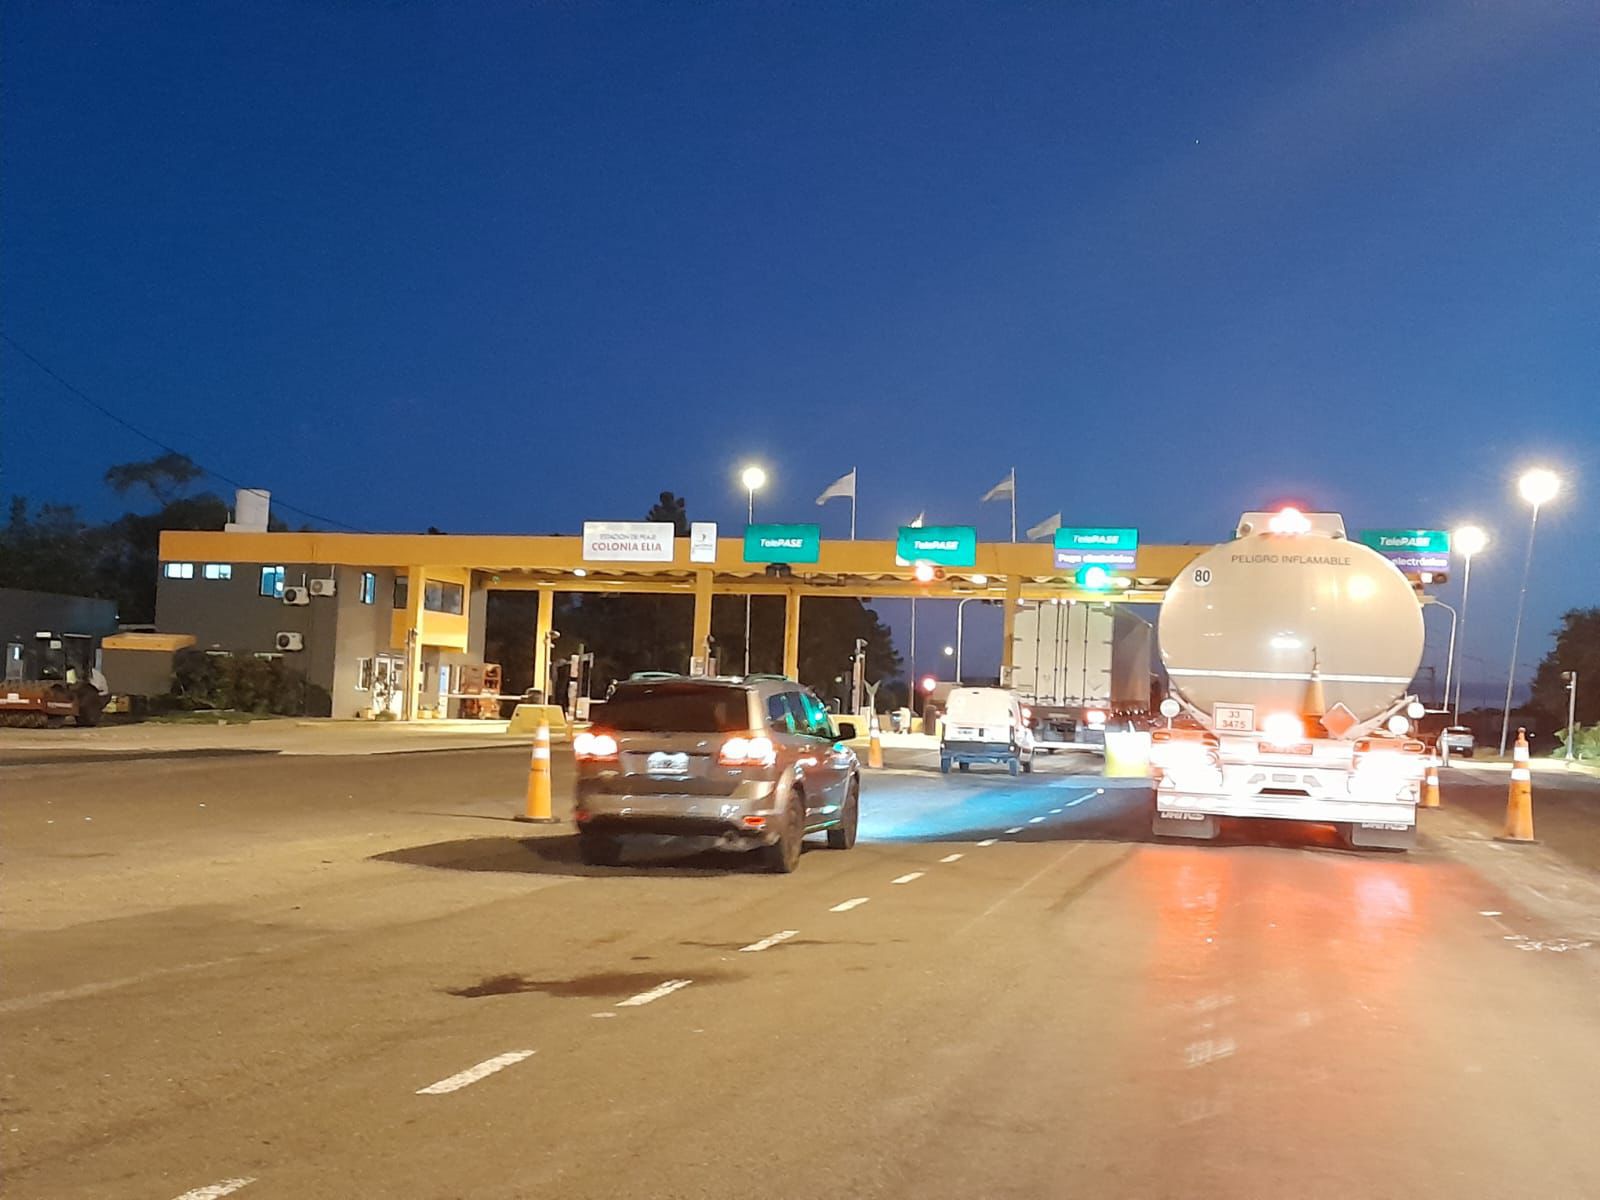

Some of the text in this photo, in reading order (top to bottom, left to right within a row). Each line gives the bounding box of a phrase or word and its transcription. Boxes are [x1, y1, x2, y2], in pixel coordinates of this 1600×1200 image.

[591, 542, 663, 552] COLONIA ELIA
[760, 538, 804, 548] TelePASE
[1231, 554, 1351, 566] PELIGRO INFLAMABLE
[1194, 569, 1211, 583] 80
[1228, 711, 1240, 719] 33
